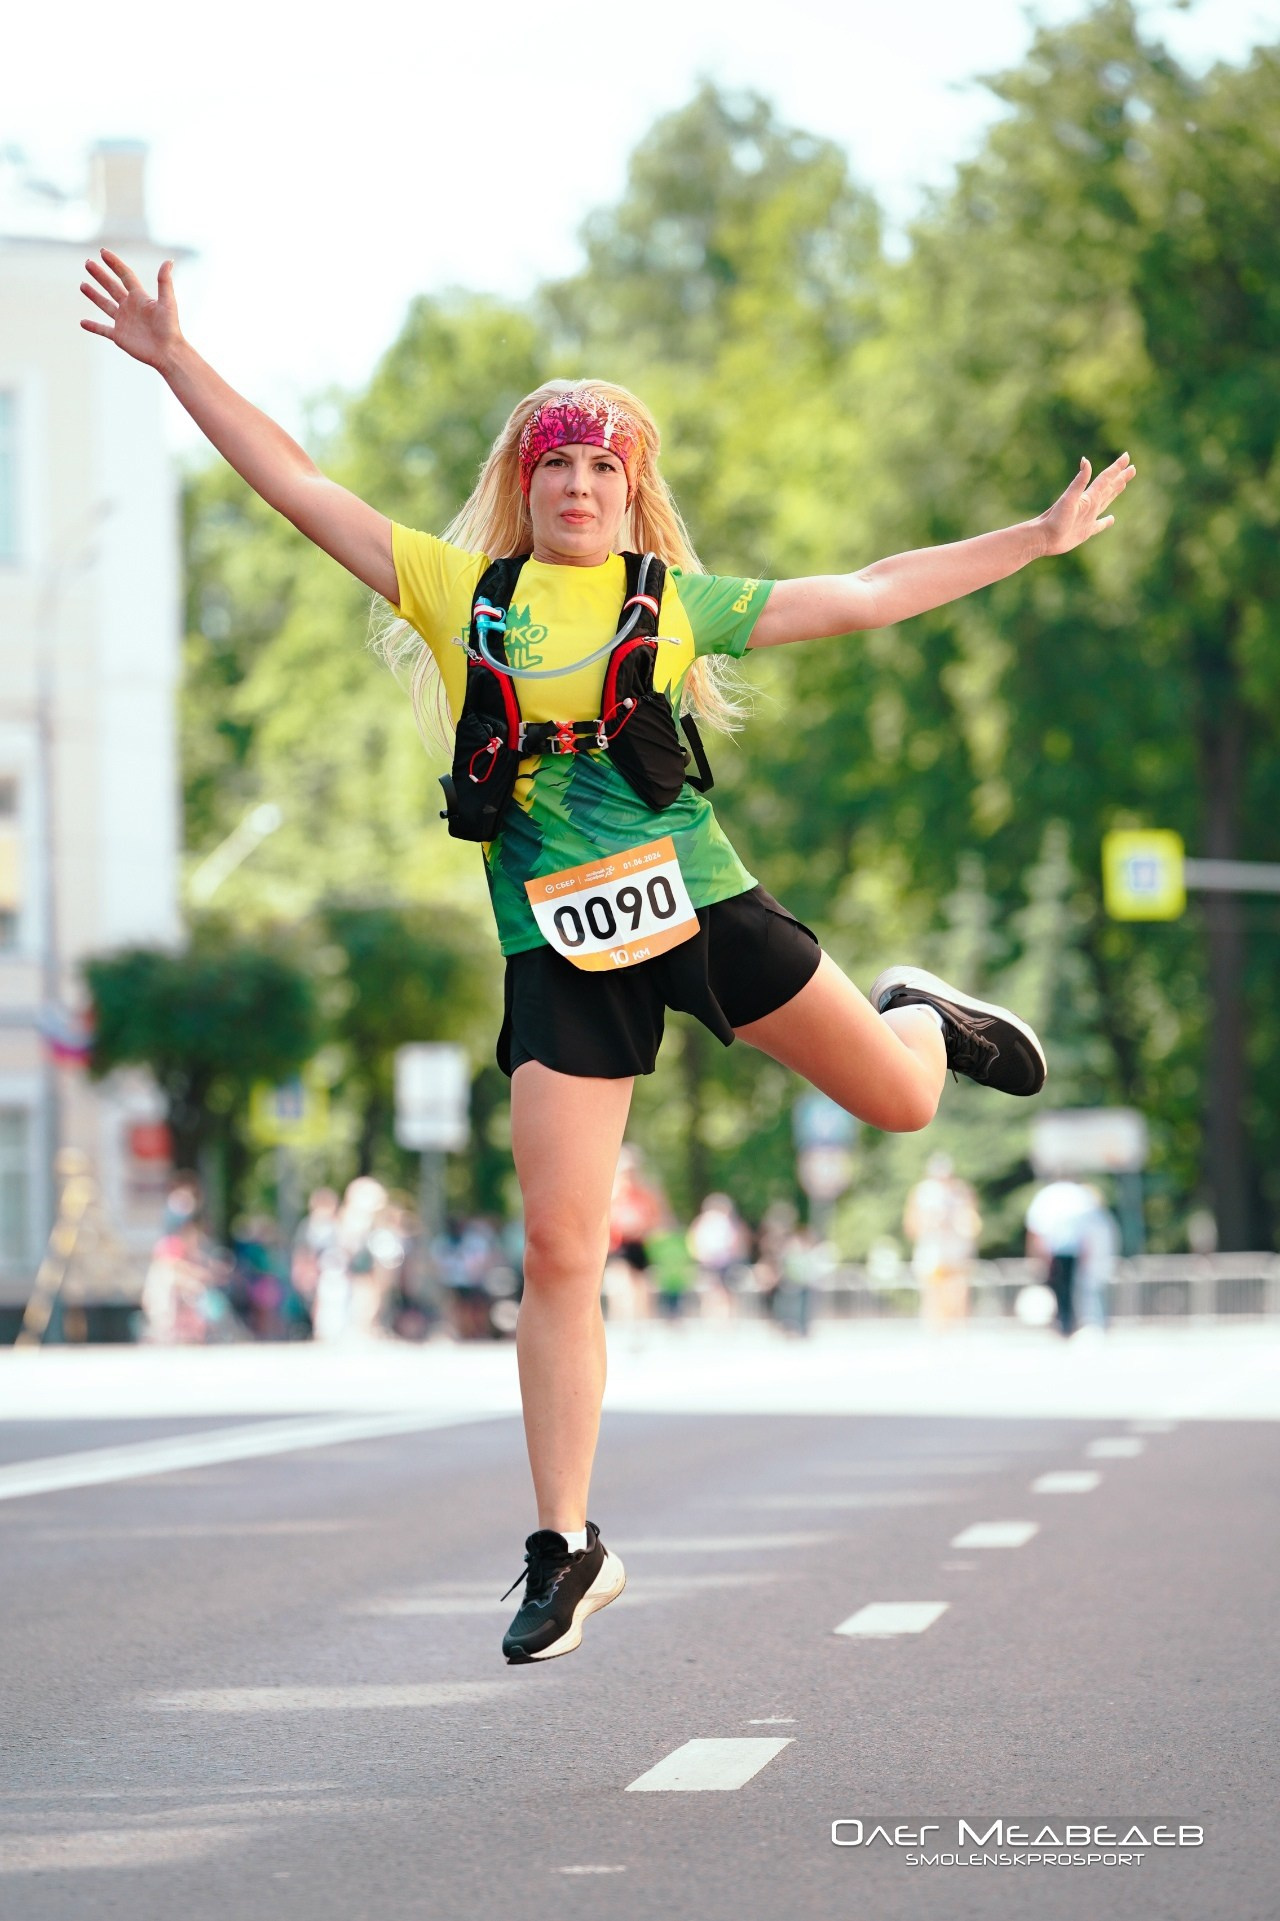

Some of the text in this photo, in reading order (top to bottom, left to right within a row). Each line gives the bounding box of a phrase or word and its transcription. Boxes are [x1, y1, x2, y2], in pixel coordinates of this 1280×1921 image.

[623, 851, 662, 870] 01.06.2024
[555, 879, 576, 890] СБЕР
[553, 875, 677, 948] 0090
[609, 949, 629, 965] 10
